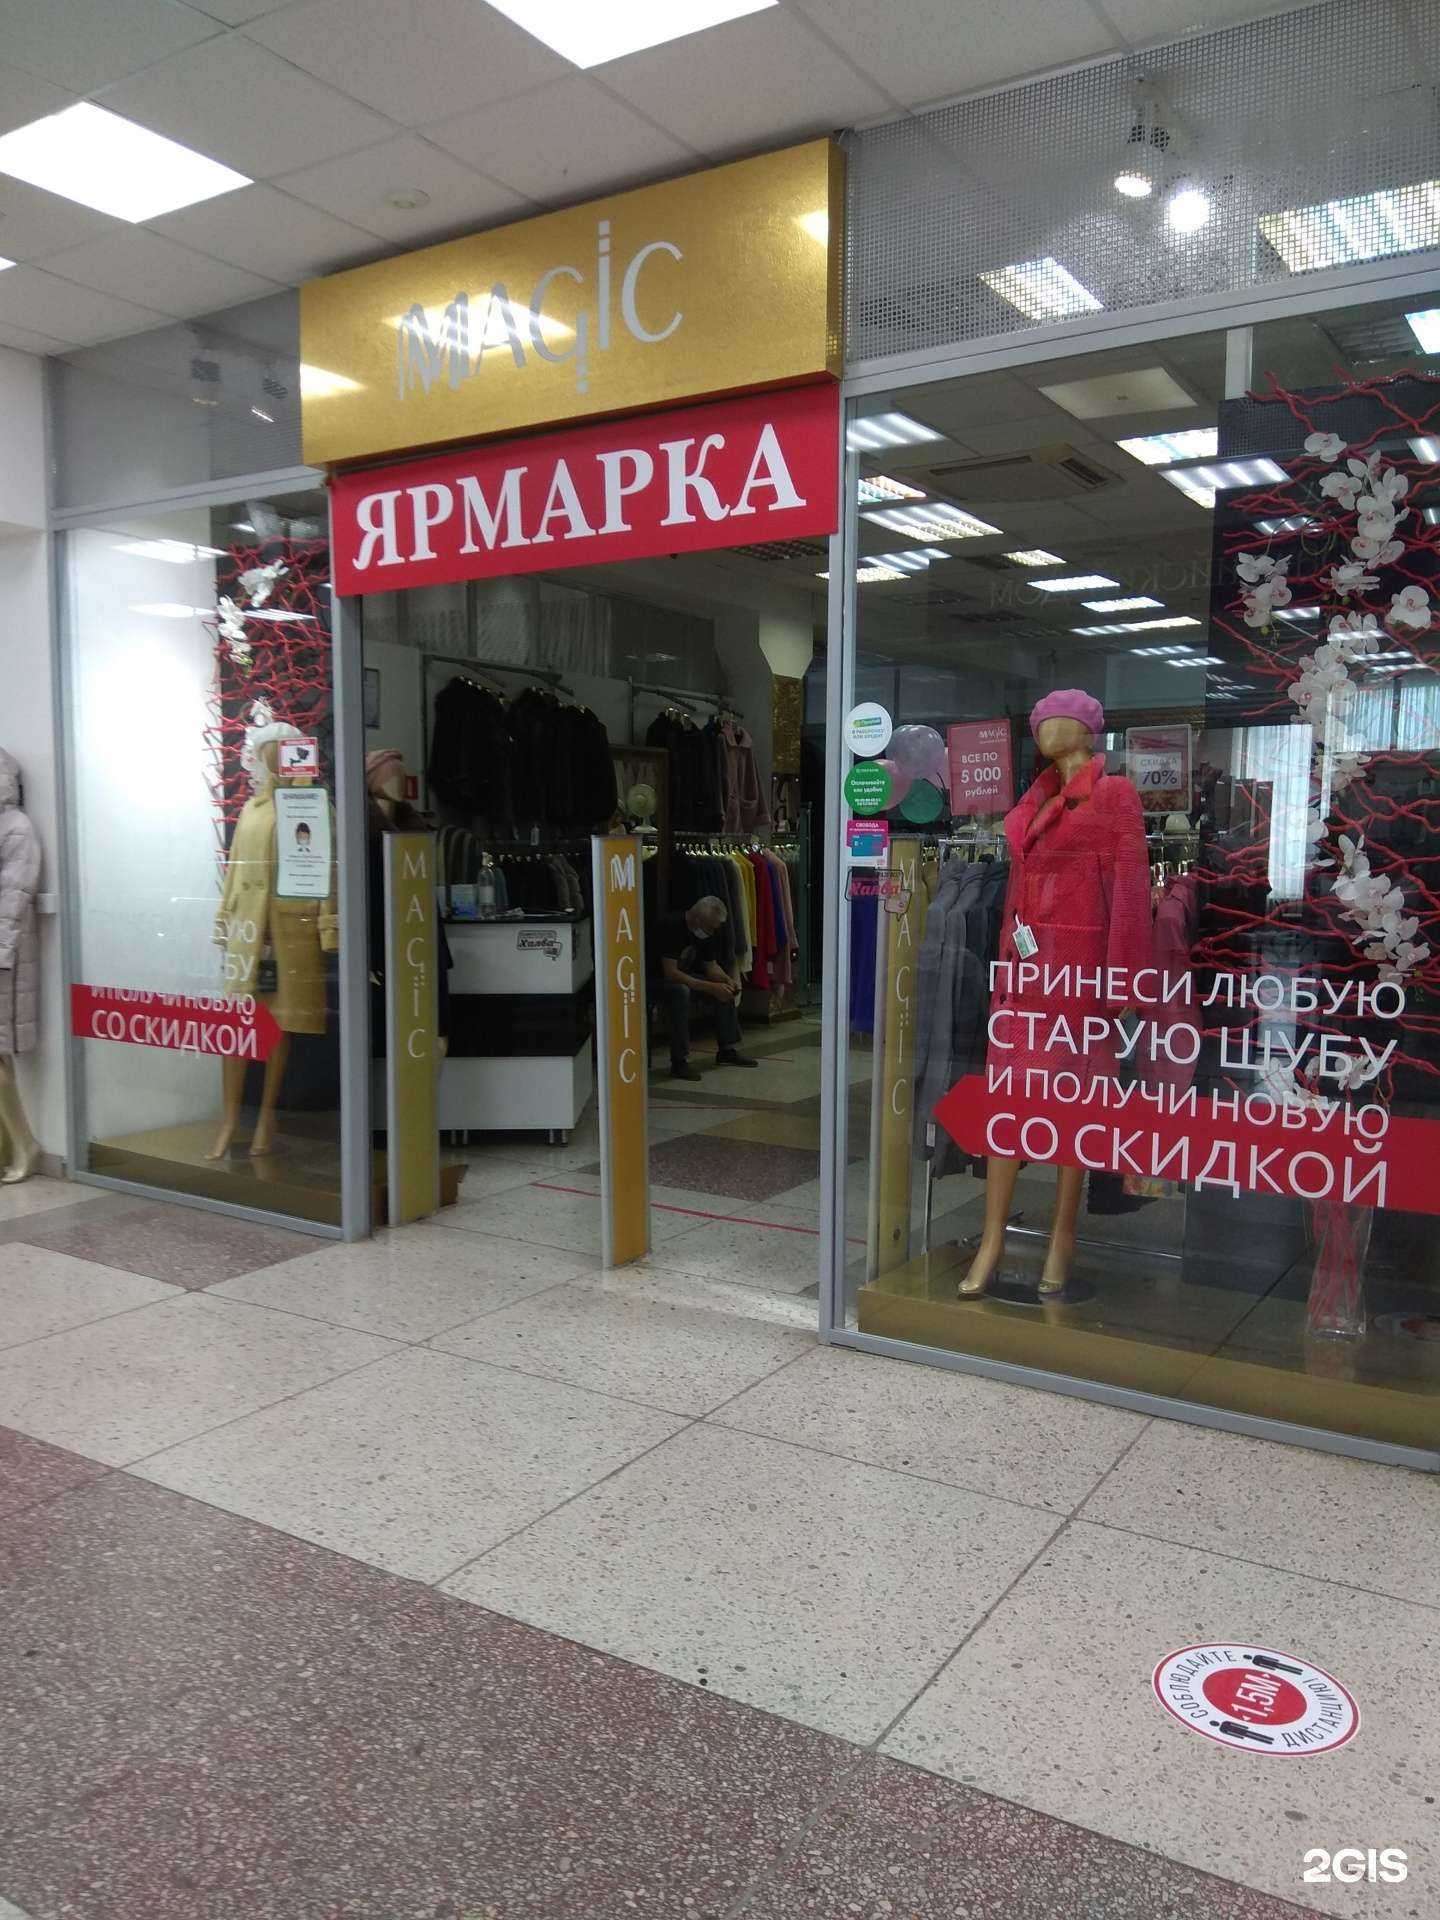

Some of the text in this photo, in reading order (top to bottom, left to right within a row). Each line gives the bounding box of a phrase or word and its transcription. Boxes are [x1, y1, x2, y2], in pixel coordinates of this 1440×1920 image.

[352, 422, 807, 570] ЯРМАРКА
[961, 752, 998, 764] ВСЕ ПО
[961, 766, 1002, 784] 5 000
[965, 785, 998, 798] рублей
[987, 960, 1406, 1020] ПРИНЕСИ ЛЮБУЮ
[91, 1009, 257, 1059] СО СКИДКОЙ
[987, 1009, 1398, 1082] СТАРУЮ ШУБУ
[988, 1063, 1390, 1140] И ПОЛУЧИ НОВУЮ
[986, 1112, 1387, 1208] СО СКИДКОЙ
[1169, 1650, 1239, 1719] СОБЛЮДАЙТЕ
